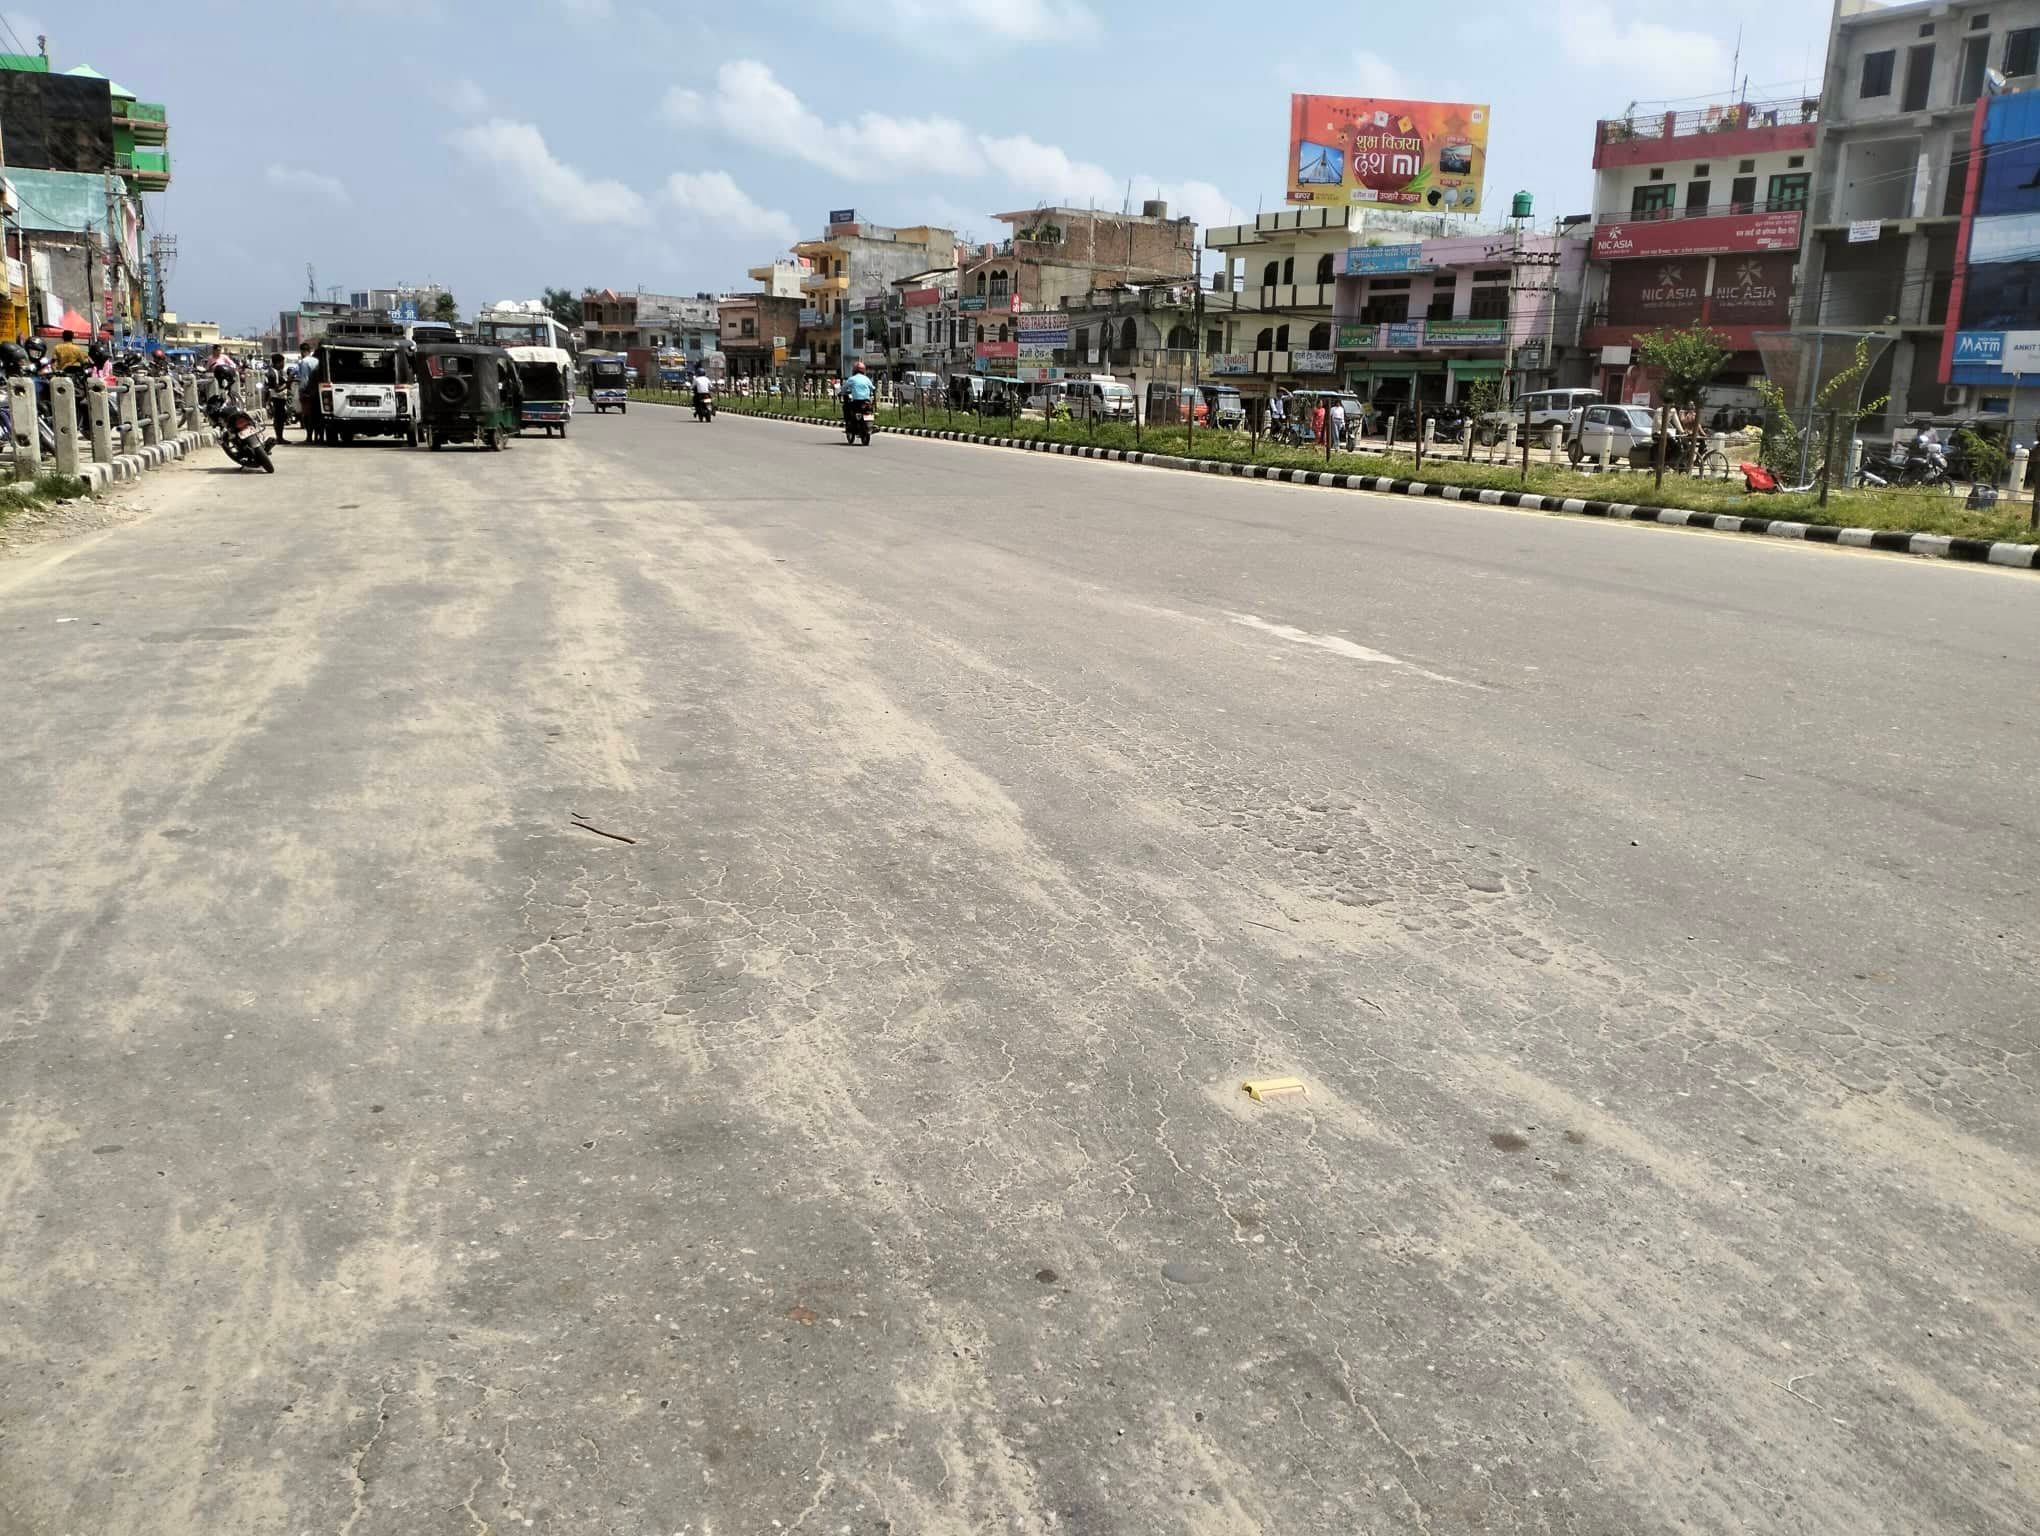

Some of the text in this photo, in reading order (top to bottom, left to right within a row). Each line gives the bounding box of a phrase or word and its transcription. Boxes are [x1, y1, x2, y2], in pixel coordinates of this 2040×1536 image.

[1356, 132, 1424, 152] शुभ विजया
[1597, 239, 1633, 250] NIC ASIA
[1641, 287, 1697, 302] NIC ASIA
[1716, 286, 1777, 299] NIC ASIA
